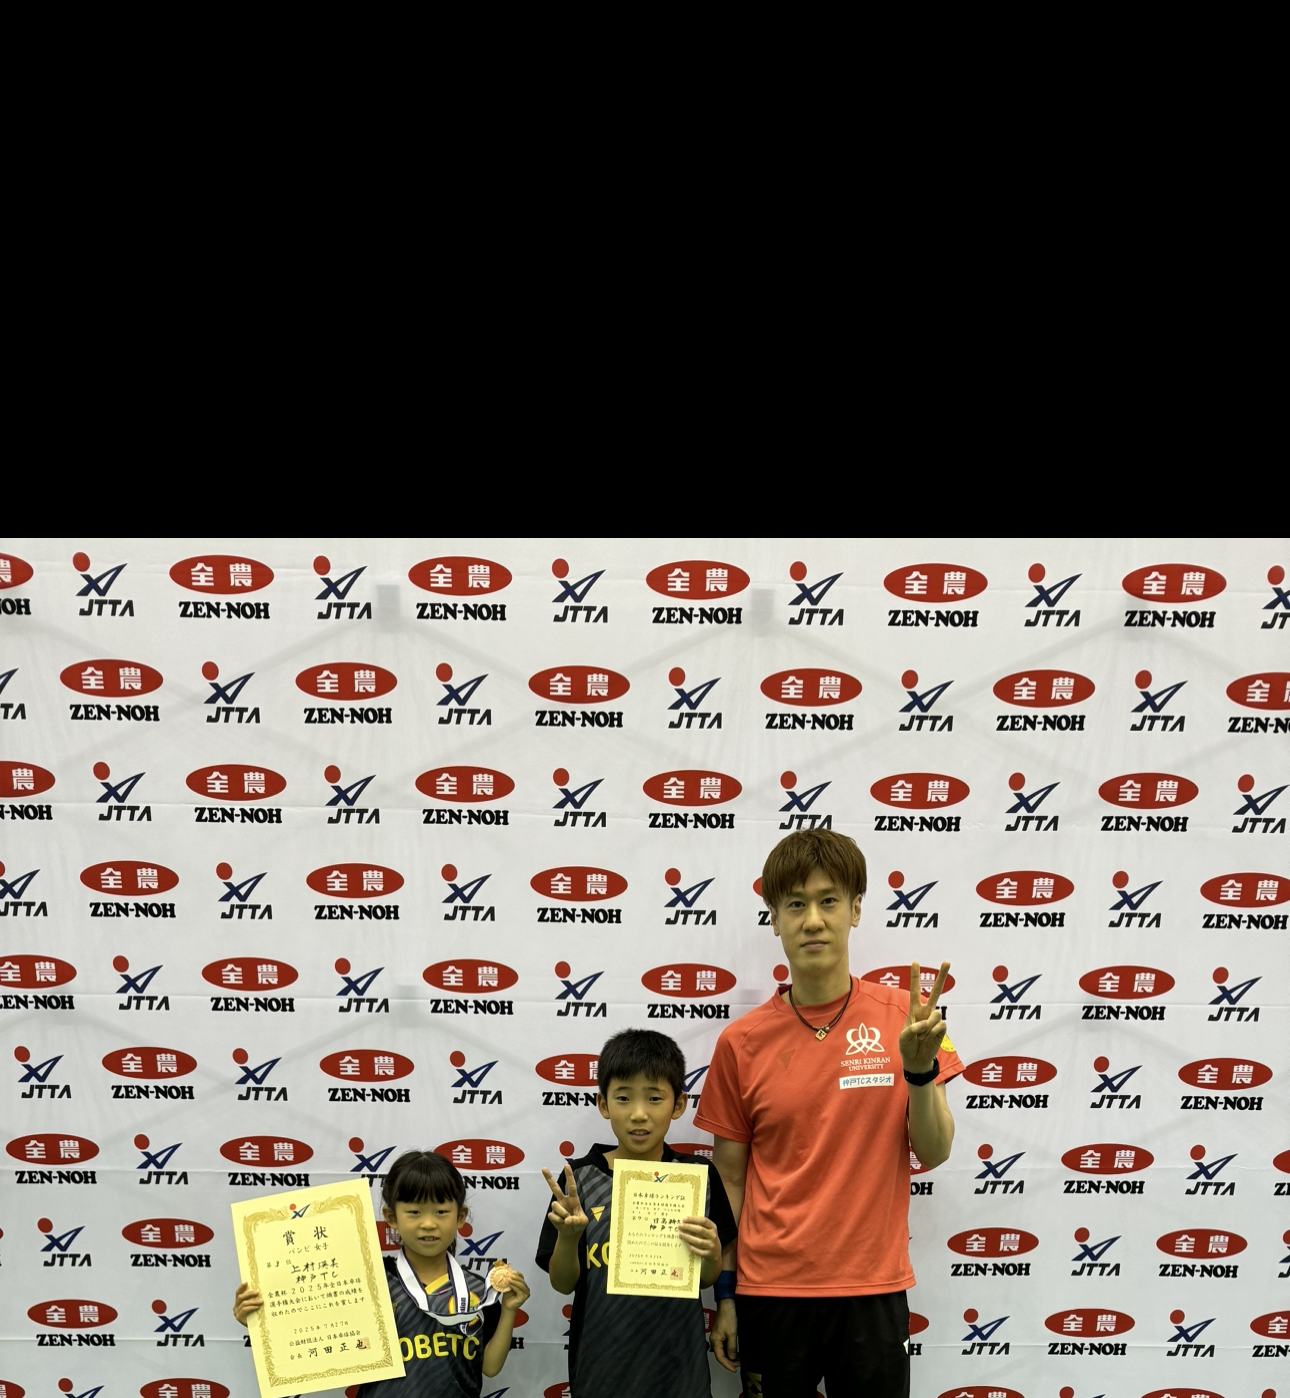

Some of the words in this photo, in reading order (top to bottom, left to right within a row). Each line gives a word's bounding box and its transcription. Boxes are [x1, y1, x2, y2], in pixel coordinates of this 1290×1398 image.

[191, 563, 252, 586] 全農
[430, 564, 490, 588] 全農
[905, 571, 966, 594] 全農
[1143, 572, 1205, 595] 全農
[79, 599, 134, 616] JTTA
[179, 602, 270, 619] ZEN-NOH
[318, 603, 371, 619] JTTA
[554, 606, 607, 622] JTTA
[653, 607, 742, 624] ZEN-NOH
[789, 609, 843, 625] JTTA
[888, 610, 979, 627] ZEN-NOH
[1025, 610, 1080, 626] JTTA
[81, 667, 141, 690] 全農
[317, 670, 375, 692] 全農
[550, 673, 608, 696] 全農
[781, 676, 841, 699] 全農
[1014, 677, 1074, 700] 全農
[207, 707, 260, 723] JTTA
[304, 708, 392, 723] ZEN-NOH
[438, 709, 491, 725] JTTA
[535, 711, 623, 727] ZEN-NOH
[766, 714, 854, 730] ZEN-NOH
[899, 715, 953, 731] JTTA
[996, 715, 1085, 731] ZEN-NOH
[1130, 716, 1185, 731] JTTA
[207, 772, 265, 793] 全農
[664, 777, 721, 799] 全農
[891, 780, 949, 801] 全農
[1119, 780, 1178, 801] 全農
[99, 806, 151, 821] JTTA
[195, 807, 282, 823] ZEN-NOH
[423, 809, 509, 825] ZEN-NOH
[554, 812, 606, 827] JTTA
[649, 813, 735, 828] ZEN-NOH
[779, 814, 832, 830] JTTA
[875, 816, 961, 831] ZEN-NOH
[1101, 816, 1188, 832] ZEN-NOH
[1232, 818, 1285, 833] JTTA
[101, 868, 158, 888] 全農
[327, 870, 383, 891] 全農
[996, 878, 1054, 898] 全農
[1220, 880, 1278, 900] 全農
[0, 902, 47, 916] JTTA
[90, 902, 176, 918] ZEN-NOH
[221, 904, 272, 919] JTTA
[444, 906, 495, 921] JTTA
[537, 908, 621, 923] ZEN-NOH
[665, 910, 716, 925] JTTA
[887, 913, 938, 927] JTTA
[980, 913, 1065, 927] ZEN-NOH
[1203, 914, 1289, 929] ZEN-NOH
[0, 962, 56, 981] 全農
[222, 964, 278, 984] 全農
[443, 966, 498, 986] 全農
[661, 970, 716, 990] 全農
[1098, 972, 1155, 992] 全農
[119, 996, 169, 1010] JTTA
[211, 997, 295, 1012] ZEN-NOH
[339, 998, 389, 1012] JTTA
[430, 999, 513, 1015] ZEN-NOH
[648, 1004, 730, 1019] ZEN-NOH
[990, 1006, 1041, 1019] JTTA
[1082, 1006, 1165, 1020] ZEN-NOH
[1208, 1007, 1259, 1021] JTTA
[340, 1056, 394, 1075] 全農
[841, 1059, 862, 1067] SENRI
[863, 1057, 890, 1065] KINRAN
[981, 1062, 1038, 1082] 全農
[1197, 1065, 1253, 1083] 全農
[842, 1076, 892, 1086] 神戸TCスタジオ
[22, 1085, 71, 1098] JTTA
[111, 1085, 194, 1099] ZEN-NOH
[328, 1088, 410, 1102] ZEN-NOH
[453, 1090, 502, 1104] JTTA
[966, 1095, 1049, 1108] ZEN-NOH
[1090, 1095, 1141, 1108] JTTA
[1181, 1096, 1263, 1110] ZEN-NOH
[239, 1142, 294, 1160] 全農
[452, 1145, 505, 1164] 全農
[1080, 1150, 1135, 1168] 全農
[15, 1171, 97, 1184] ZEN-NOH
[139, 1171, 188, 1184] JTTA
[974, 1181, 1024, 1194] JTTA
[1064, 1181, 1145, 1194] ZEN-NOH
[1185, 1182, 1235, 1195] JTTA
[141, 1225, 194, 1242] 全農
[1175, 1235, 1229, 1253] 全農
[44, 1254, 91, 1266] JTTA
[131, 1254, 211, 1267] ZEN-NOH
[951, 1263, 1031, 1276] ZEN-NOH
[1071, 1263, 1120, 1276] JTTA
[46, 1305, 99, 1322] 全農
[1063, 1315, 1116, 1331] 全農
[36, 1334, 115, 1346] ZEN-NOH
[157, 1334, 204, 1346] JTTA
[399, 1332, 480, 1361] OBETC
[962, 1343, 1009, 1355] JTTA
[1167, 1344, 1214, 1357] JTTA
